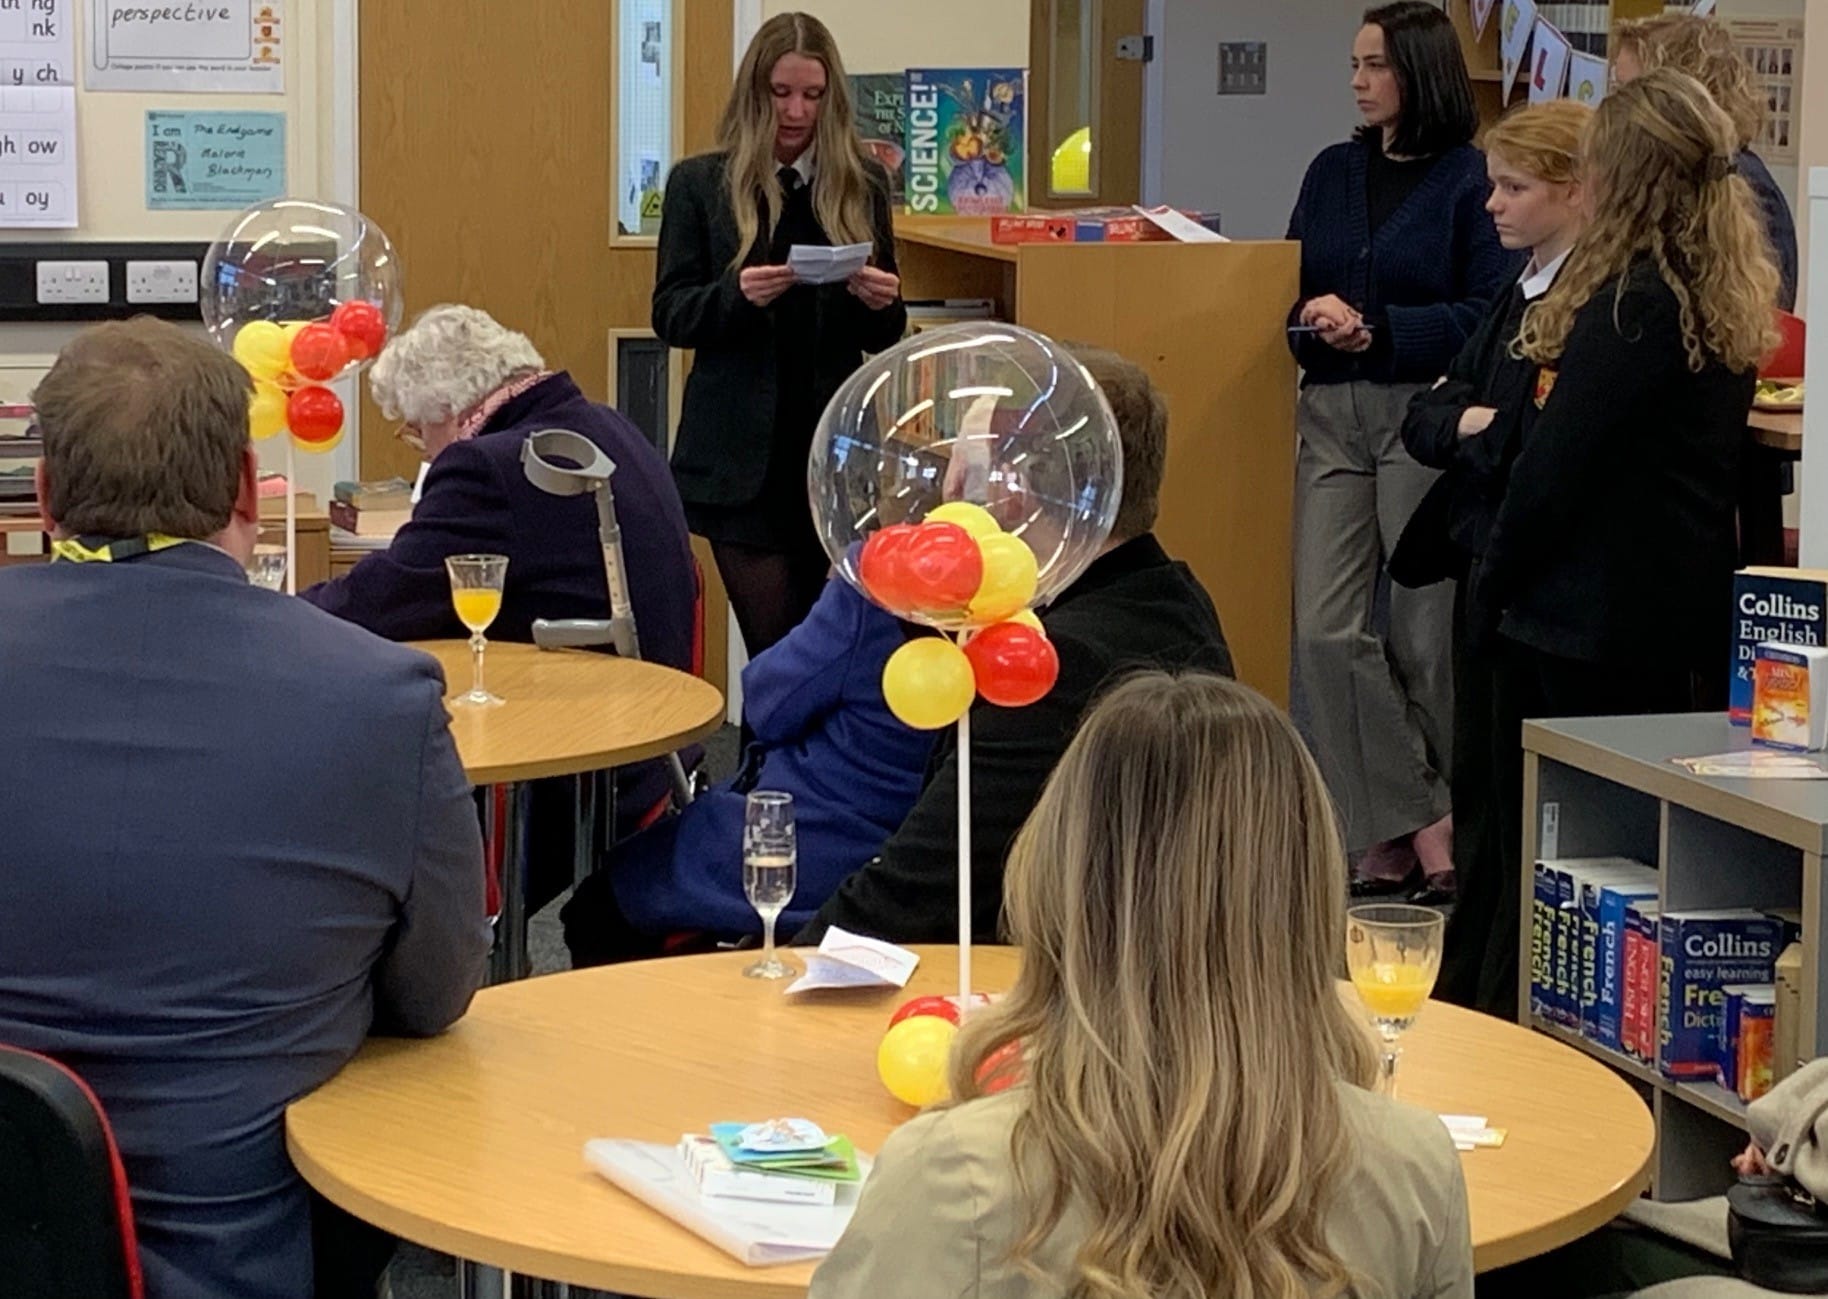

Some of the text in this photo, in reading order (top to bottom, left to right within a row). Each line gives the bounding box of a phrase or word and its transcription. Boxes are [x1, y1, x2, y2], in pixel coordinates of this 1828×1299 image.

[31, 0, 55, 16] ng
[111, 3, 231, 28] perspective
[32, 18, 56, 36] nk
[13, 63, 59, 86] y ch
[163, 127, 181, 137] am
[217, 123, 273, 141] Endgame
[28, 141, 58, 154] ow
[911, 83, 939, 213] SCIENCE!
[25, 192, 49, 211] oy
[1740, 593, 1820, 620] Collins
[1739, 619, 1818, 646] English
[1531, 899, 1544, 984] French
[1542, 905, 1555, 991] French
[1556, 910, 1571, 995] French
[1684, 932, 1772, 957] Collins
[1582, 920, 1599, 1007] French
[1601, 920, 1616, 1006] French
[1684, 966, 1770, 981] easy learning
[1660, 956, 1674, 1046] French
[1684, 984, 1724, 1007] Fre
